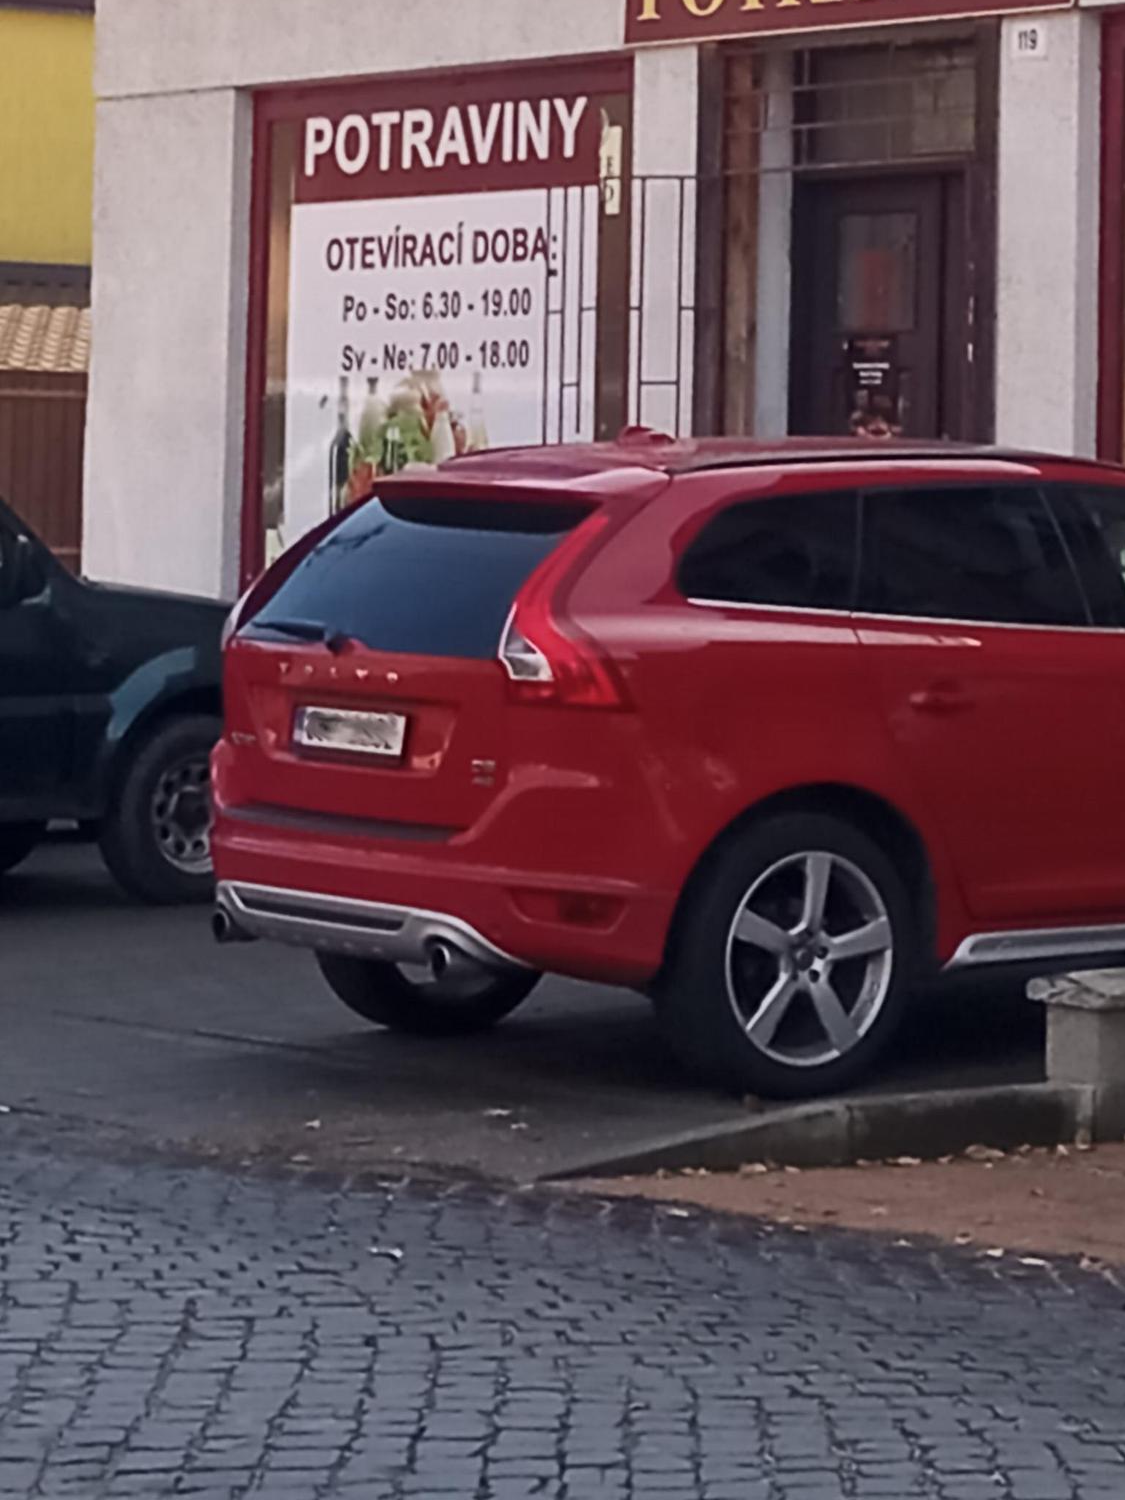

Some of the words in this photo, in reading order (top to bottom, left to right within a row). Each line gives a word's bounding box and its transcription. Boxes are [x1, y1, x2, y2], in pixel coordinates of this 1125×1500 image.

[1018, 28, 1037, 50] 119
[303, 96, 589, 177] POTRAVINY
[325, 221, 464, 271] OTEVÍRACÍ
[472, 226, 558, 265] DOBA:
[342, 295, 367, 322] Po
[384, 293, 416, 320] So:
[422, 290, 461, 318] 6.30
[481, 287, 531, 316] 19.00
[341, 345, 366, 372] Sv
[383, 343, 414, 370] Ne:
[420, 342, 459, 369] 7.00
[480, 339, 530, 368] 18.00
